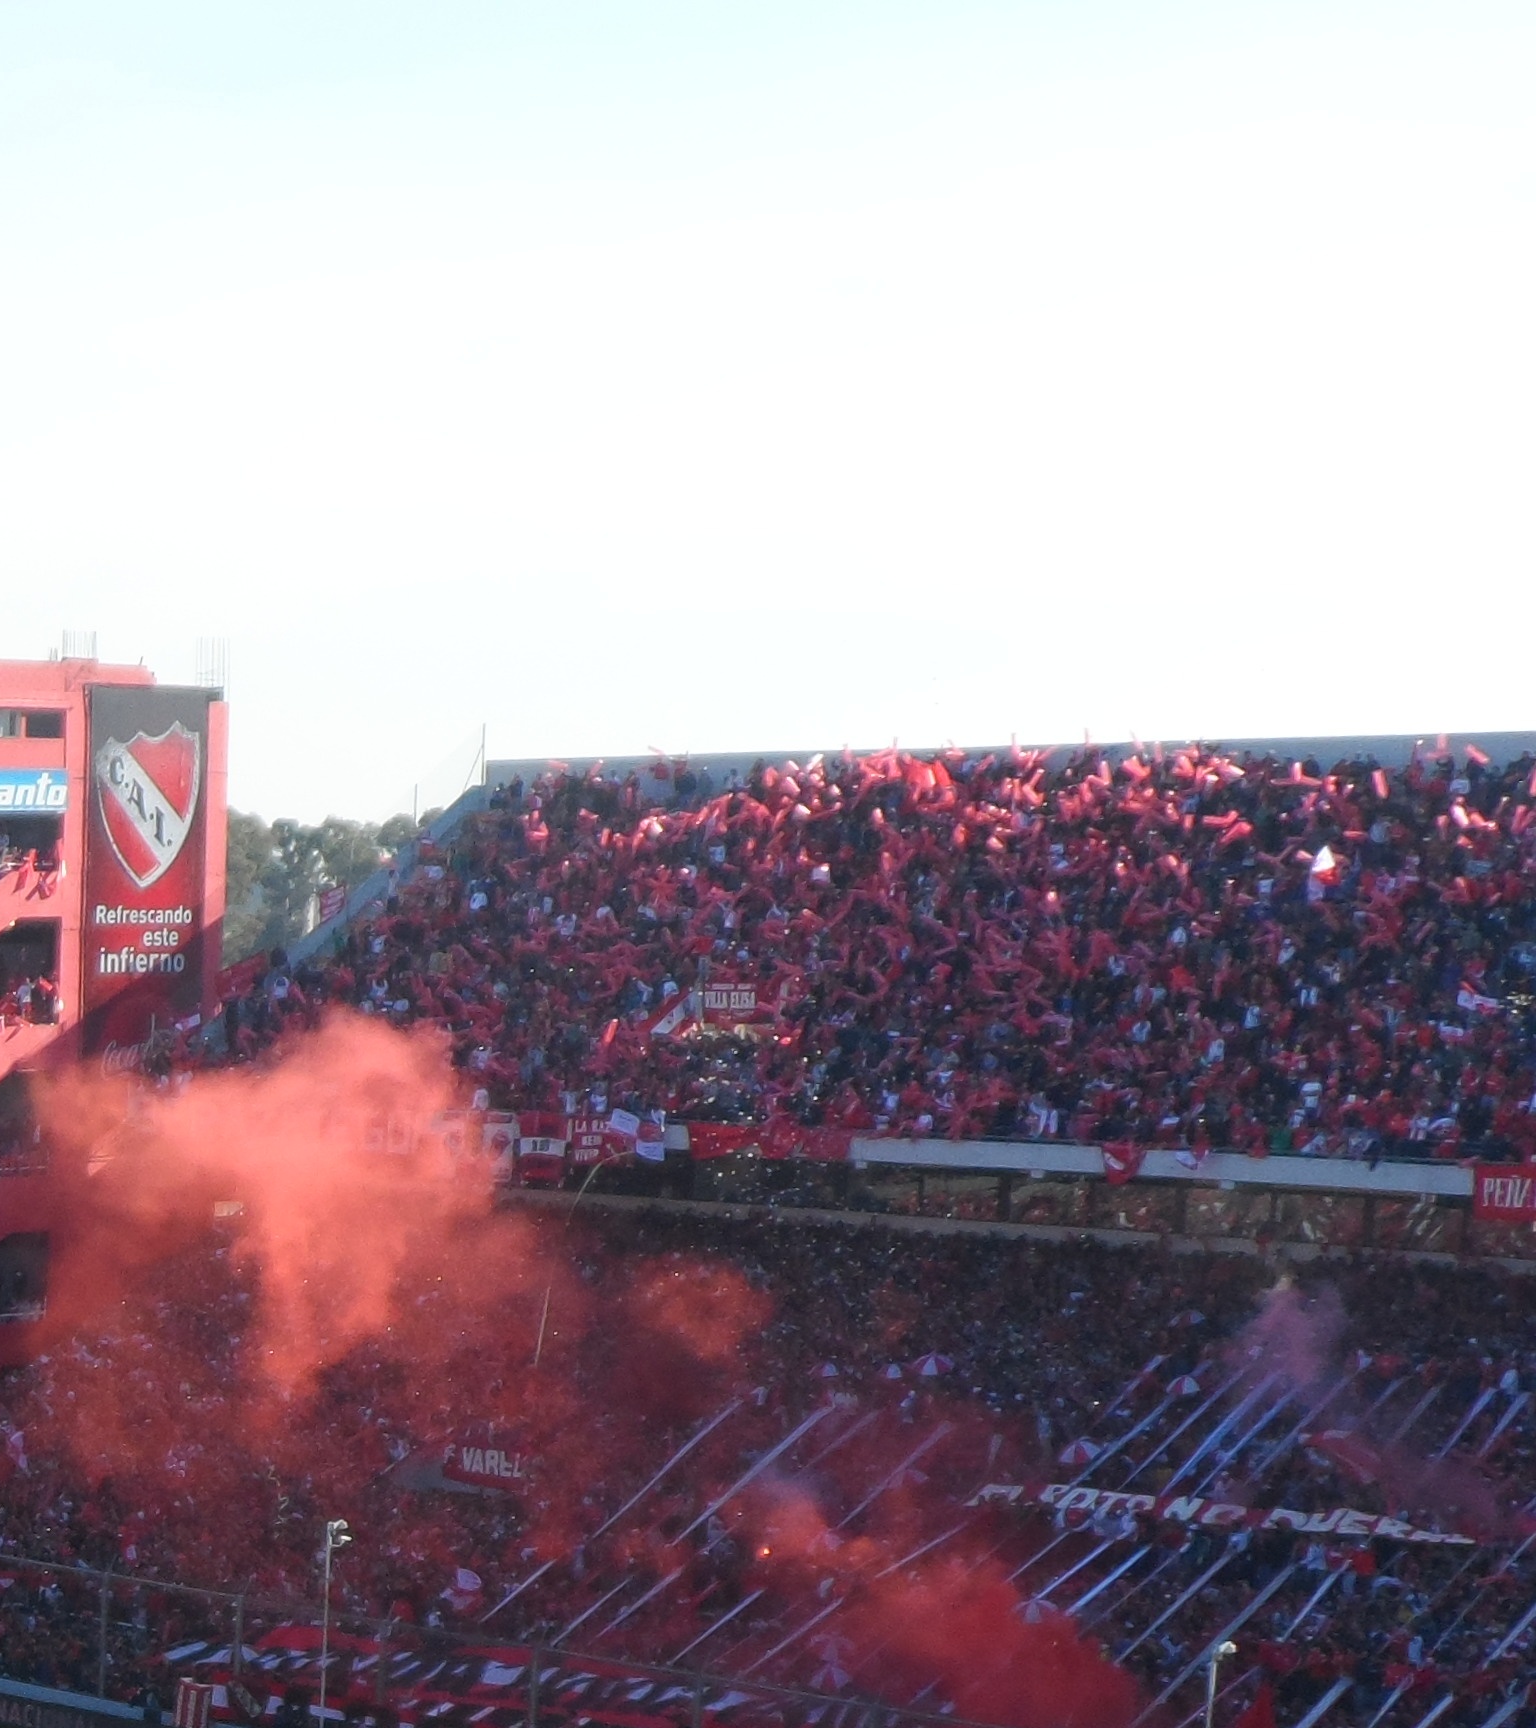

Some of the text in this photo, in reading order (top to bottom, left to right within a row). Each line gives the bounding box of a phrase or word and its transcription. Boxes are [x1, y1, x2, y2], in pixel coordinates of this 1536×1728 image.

[95, 905, 193, 925] Refrescando
[143, 929, 179, 947] este
[99, 948, 186, 974] infierno
